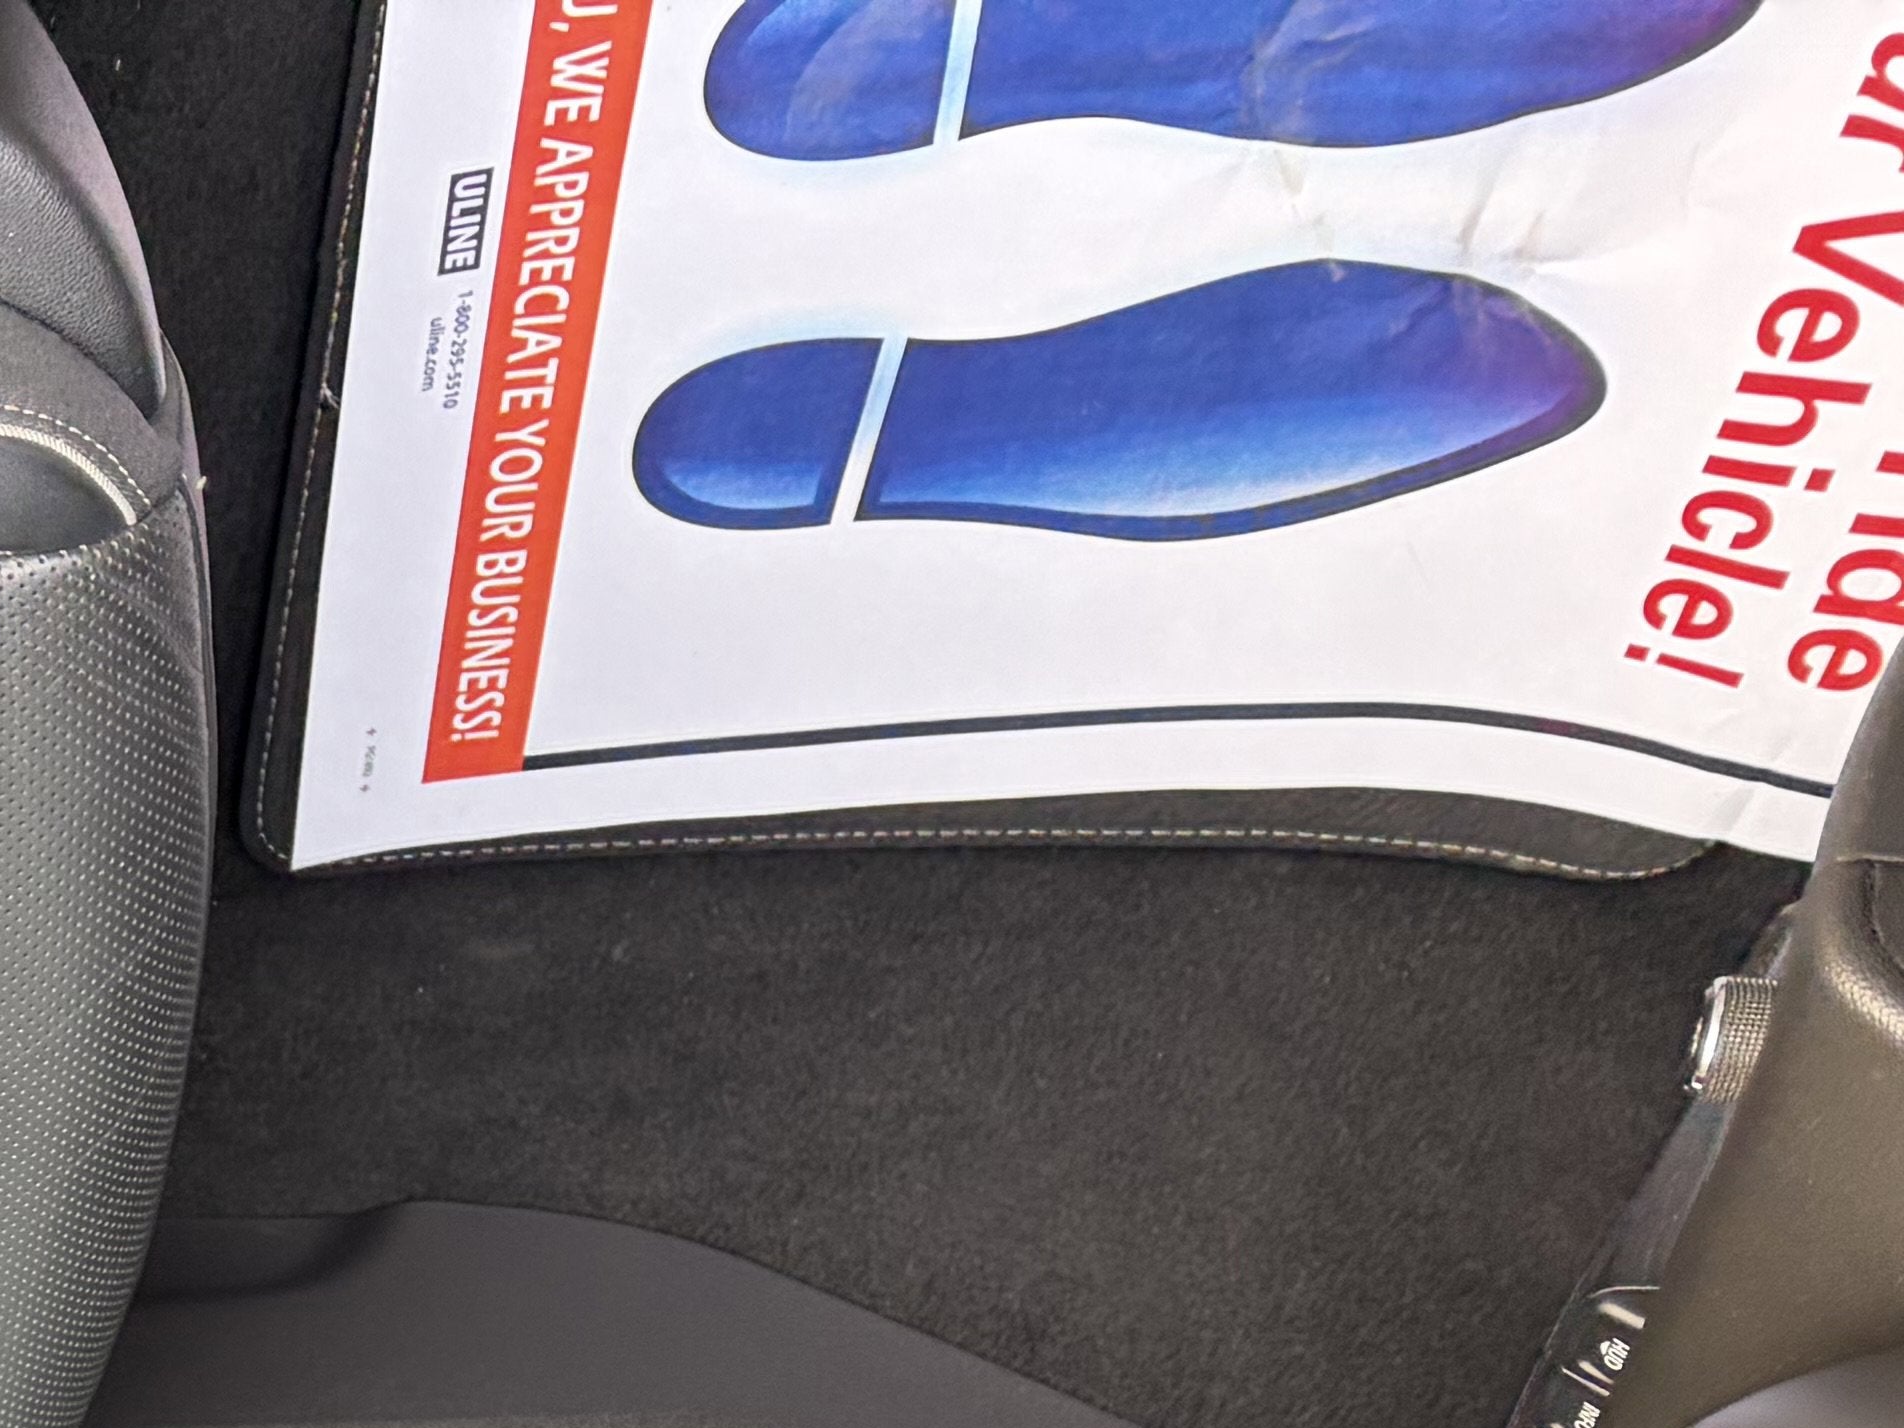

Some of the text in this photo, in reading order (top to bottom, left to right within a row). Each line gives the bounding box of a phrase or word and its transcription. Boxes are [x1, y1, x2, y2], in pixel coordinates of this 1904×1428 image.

[544, 40, 612, 126] WE
[444, 173, 487, 270] ULINE
[499, 137, 593, 414] APPRECIATE
[422, 317, 442, 392] uline.com
[442, 290, 473, 409] 1-800-295-5510
[480, 419, 549, 542] YOUR
[1623, 211, 1904, 688] Vehicle!
[450, 549, 528, 742] BUSINESS!
[1604, 1338, 1630, 1371] HUD
